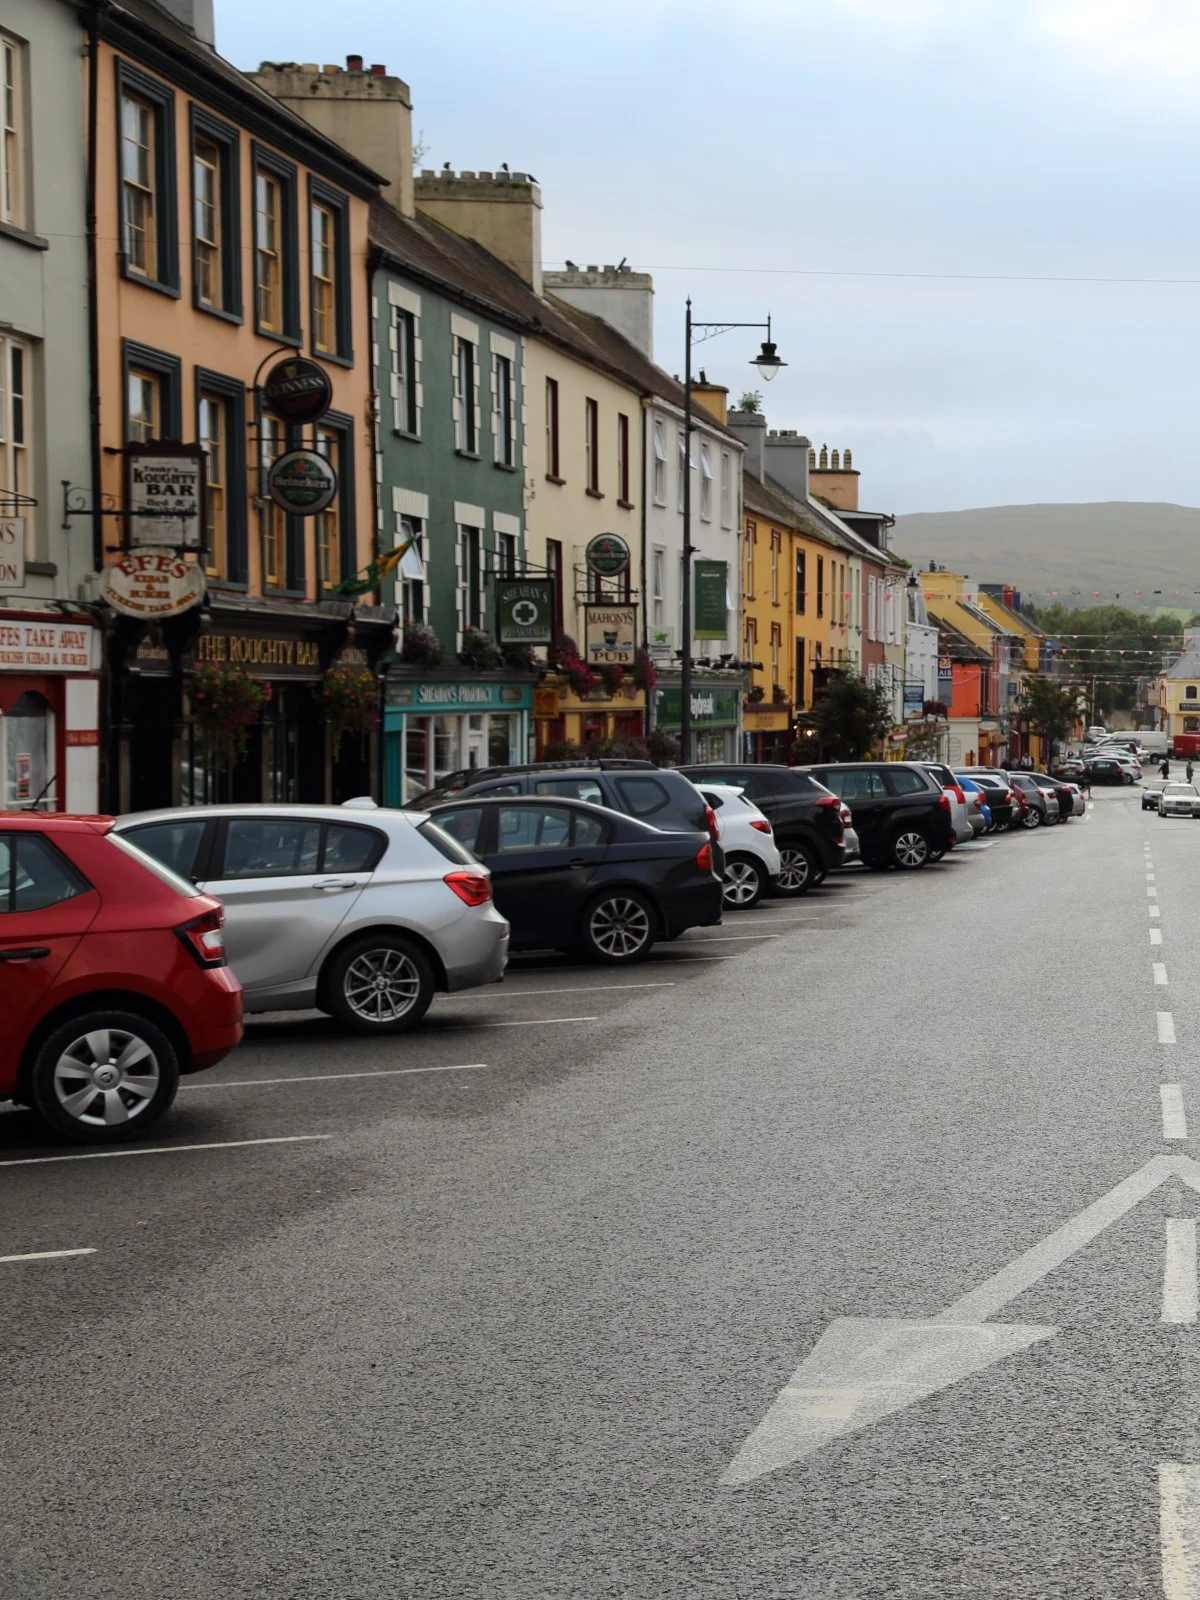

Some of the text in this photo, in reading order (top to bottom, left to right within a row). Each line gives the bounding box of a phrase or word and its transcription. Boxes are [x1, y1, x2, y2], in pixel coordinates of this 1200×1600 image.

[146, 484, 194, 496] BAR
[115, 555, 189, 579] EFES
[25, 628, 54, 647] TAKE
[59, 631, 86, 649] AWAY
[198, 635, 225, 661] THE
[229, 636, 293, 665] ROUGHTY
[295, 642, 319, 665] BAR
[593, 652, 629, 661] PUB
